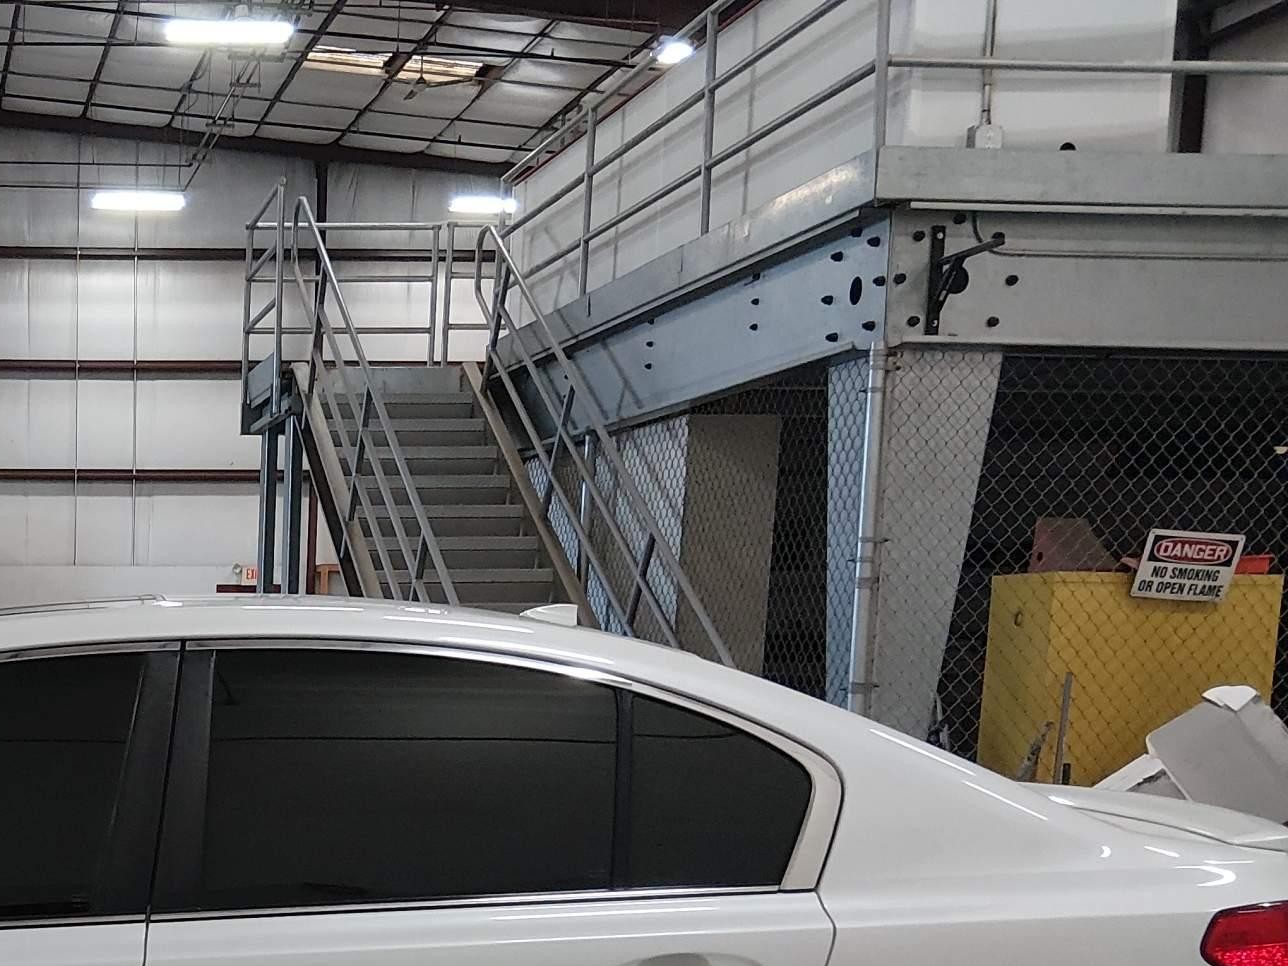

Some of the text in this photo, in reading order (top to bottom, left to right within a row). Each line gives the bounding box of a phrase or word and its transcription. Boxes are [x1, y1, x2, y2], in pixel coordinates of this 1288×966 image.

[1159, 542, 1228, 560] DANGER
[1150, 565, 1220, 582] NO SMOKING
[1137, 579, 1224, 597] OR OPEN FLAME
